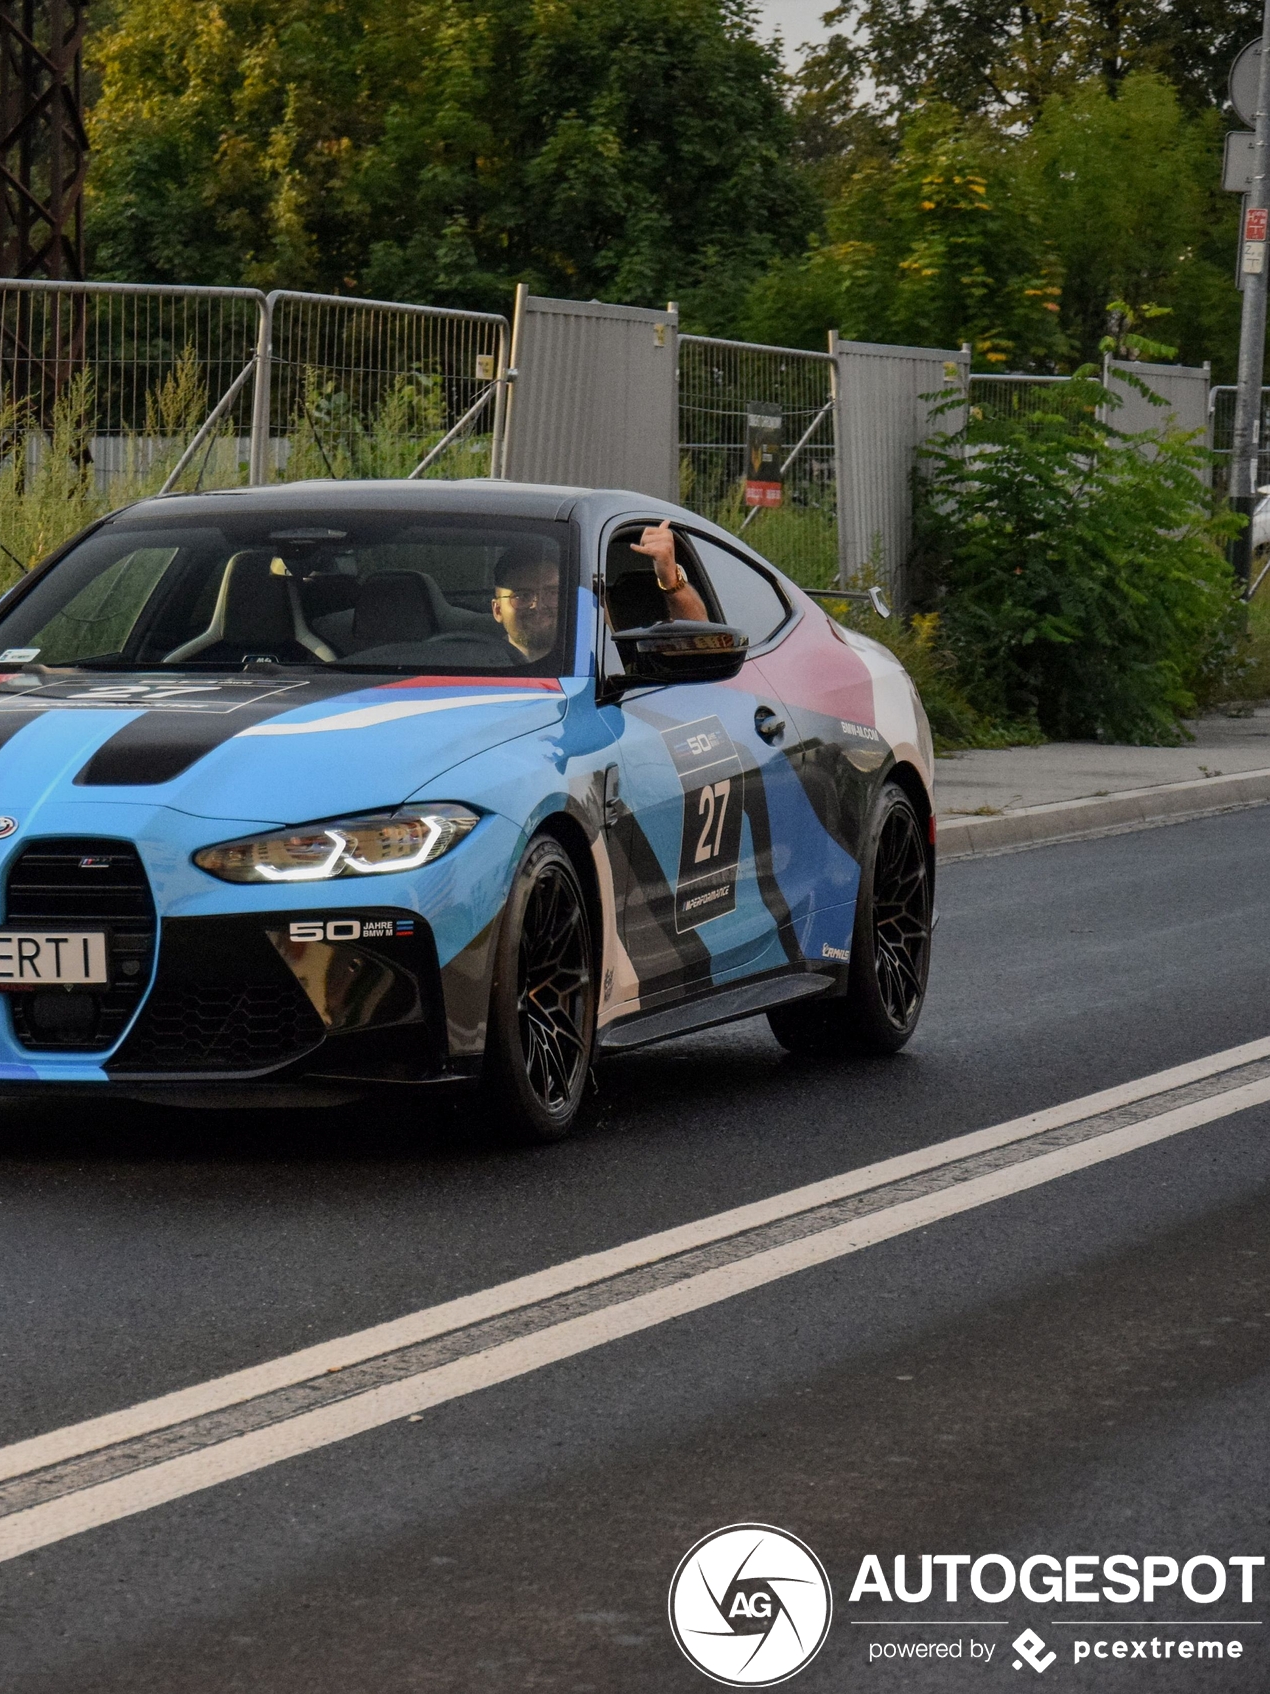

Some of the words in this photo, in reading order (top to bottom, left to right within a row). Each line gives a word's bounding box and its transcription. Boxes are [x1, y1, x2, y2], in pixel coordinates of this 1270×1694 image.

[66, 685, 223, 699] 27
[686, 733, 712, 755] 50
[694, 779, 731, 864] 27
[289, 920, 361, 942] 50
[363, 921, 393, 930] JAHRE
[363, 929, 384, 937] BMW
[385, 928, 394, 936] M
